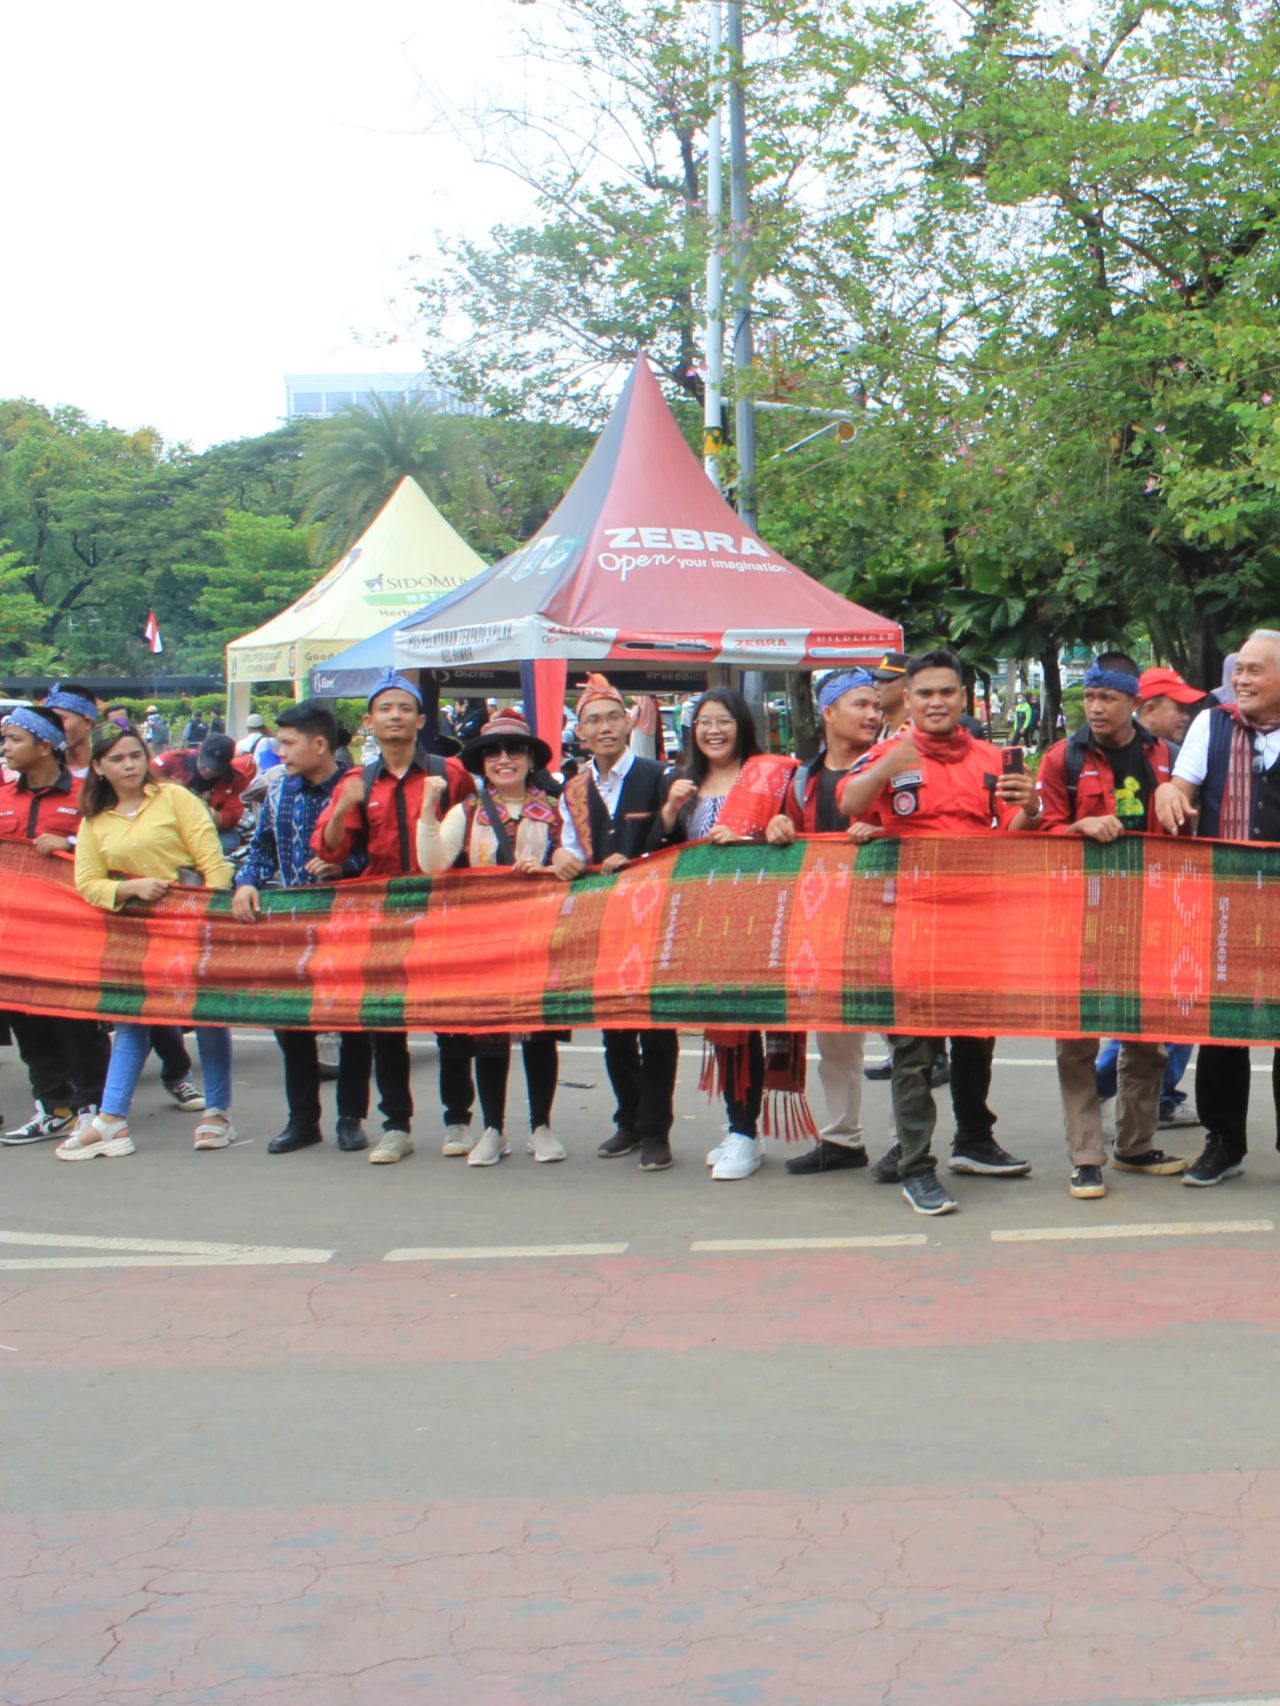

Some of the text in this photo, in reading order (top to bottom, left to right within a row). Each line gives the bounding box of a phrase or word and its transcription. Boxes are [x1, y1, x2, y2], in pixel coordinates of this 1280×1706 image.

[603, 527, 770, 557] ZEBRA
[598, 552, 676, 582] Open
[677, 557, 707, 569] your
[735, 638, 787, 647] ZEBRA
[816, 633, 895, 643] MILDLINER
